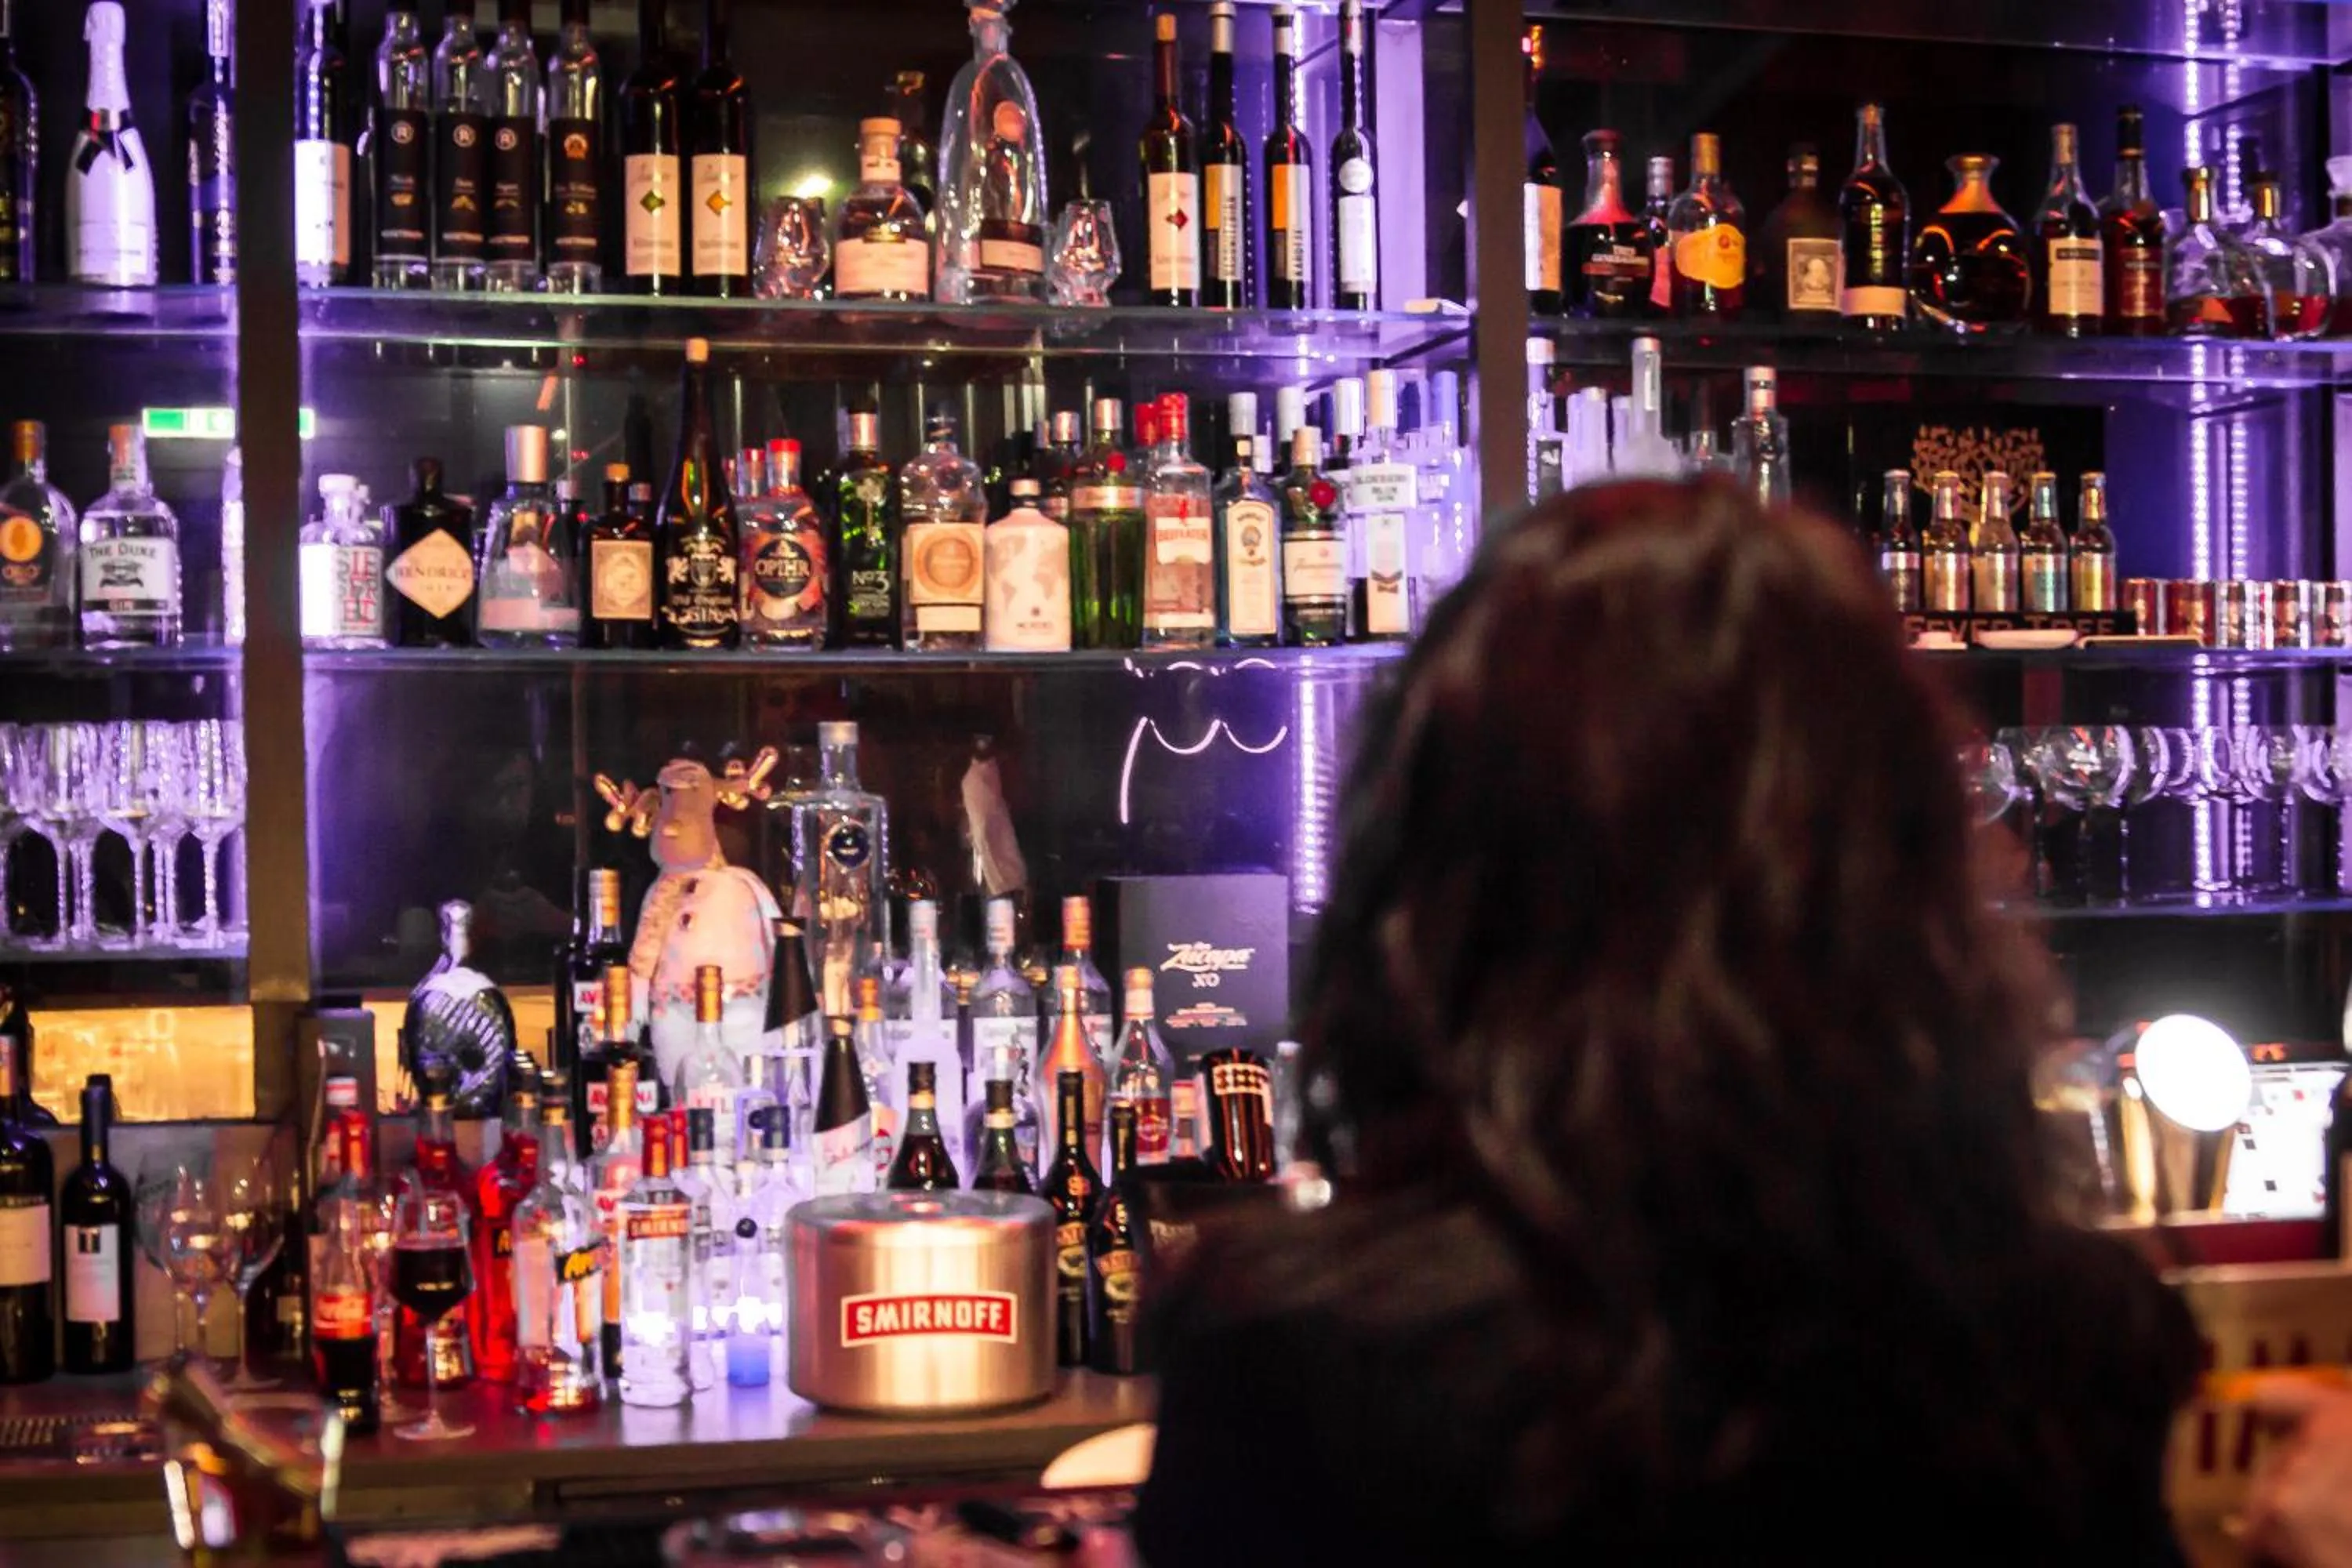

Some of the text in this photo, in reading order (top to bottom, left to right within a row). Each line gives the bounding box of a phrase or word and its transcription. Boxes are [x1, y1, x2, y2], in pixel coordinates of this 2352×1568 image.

[89, 542, 156, 559] THE DUKE
[754, 559, 810, 578] OPIHR
[856, 1301, 1004, 1334] SMIRNOFF
